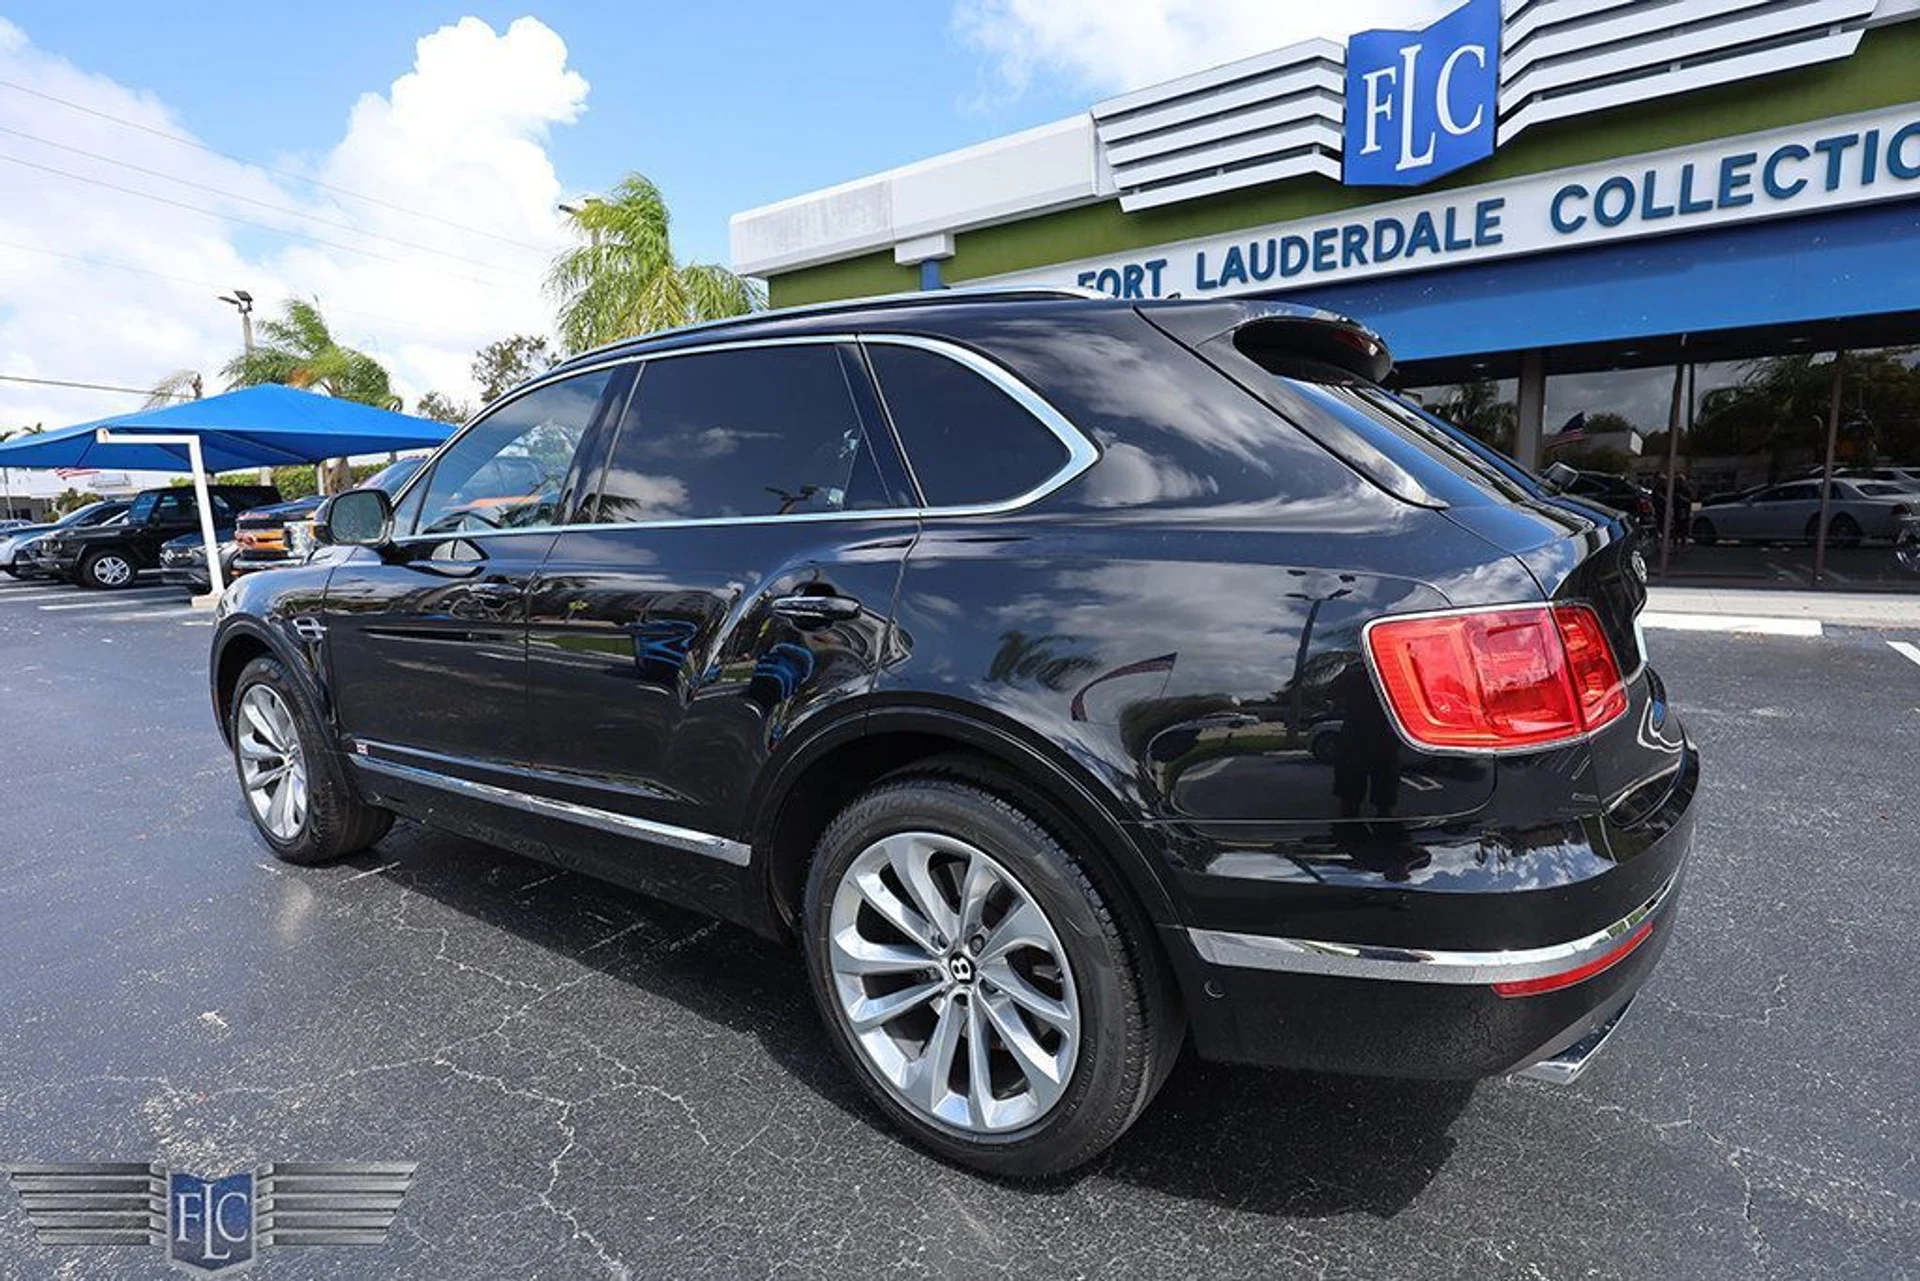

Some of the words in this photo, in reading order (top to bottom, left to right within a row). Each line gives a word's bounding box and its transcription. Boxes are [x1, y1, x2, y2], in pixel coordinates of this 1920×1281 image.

[1360, 43, 1486, 171] FLC
[1197, 199, 1504, 288] LAUDERDALE
[951, 957, 970, 980] B
